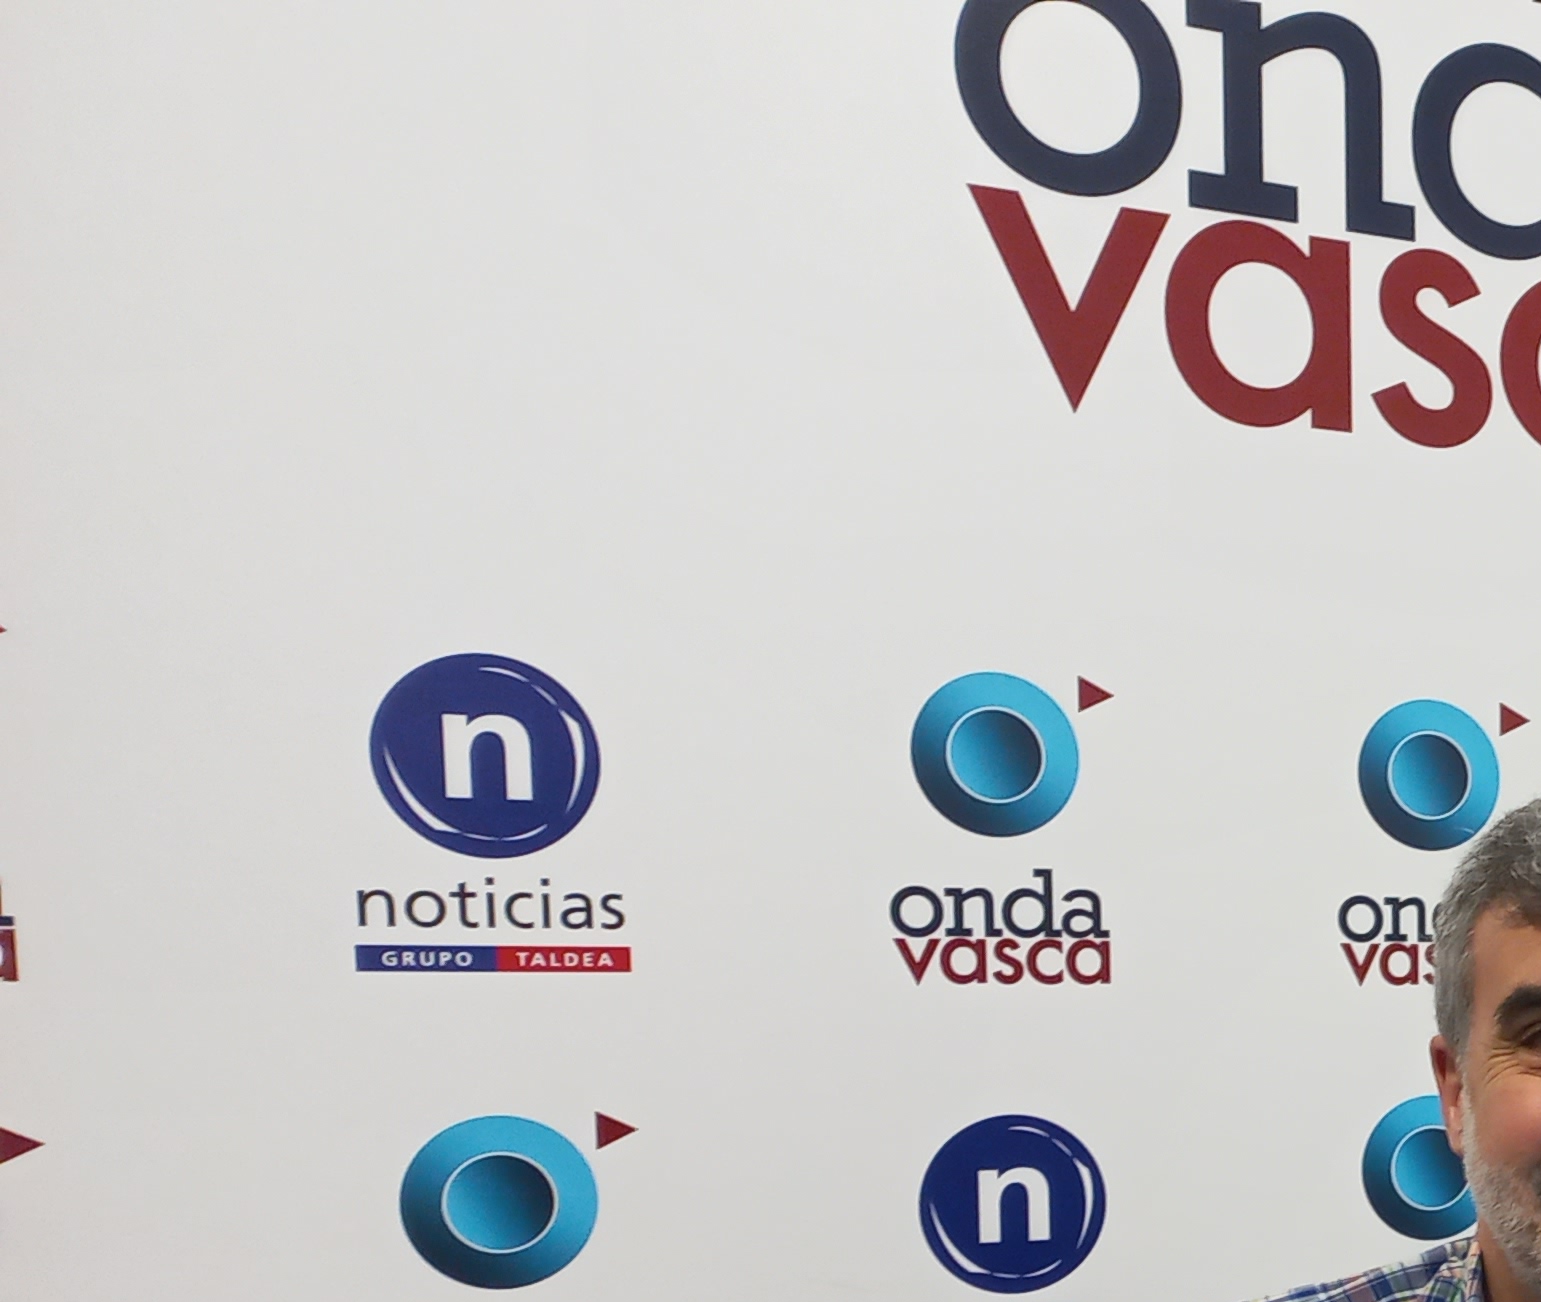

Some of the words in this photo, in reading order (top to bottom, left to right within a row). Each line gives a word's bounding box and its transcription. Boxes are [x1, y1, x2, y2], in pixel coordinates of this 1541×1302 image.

[441, 714, 535, 801] n
[357, 878, 626, 930] noticias
[889, 868, 1110, 940] onda
[381, 950, 474, 967] GRUPO
[515, 951, 614, 967] TALDEA
[892, 935, 1112, 986] vasca
[975, 1162, 1050, 1244] n
